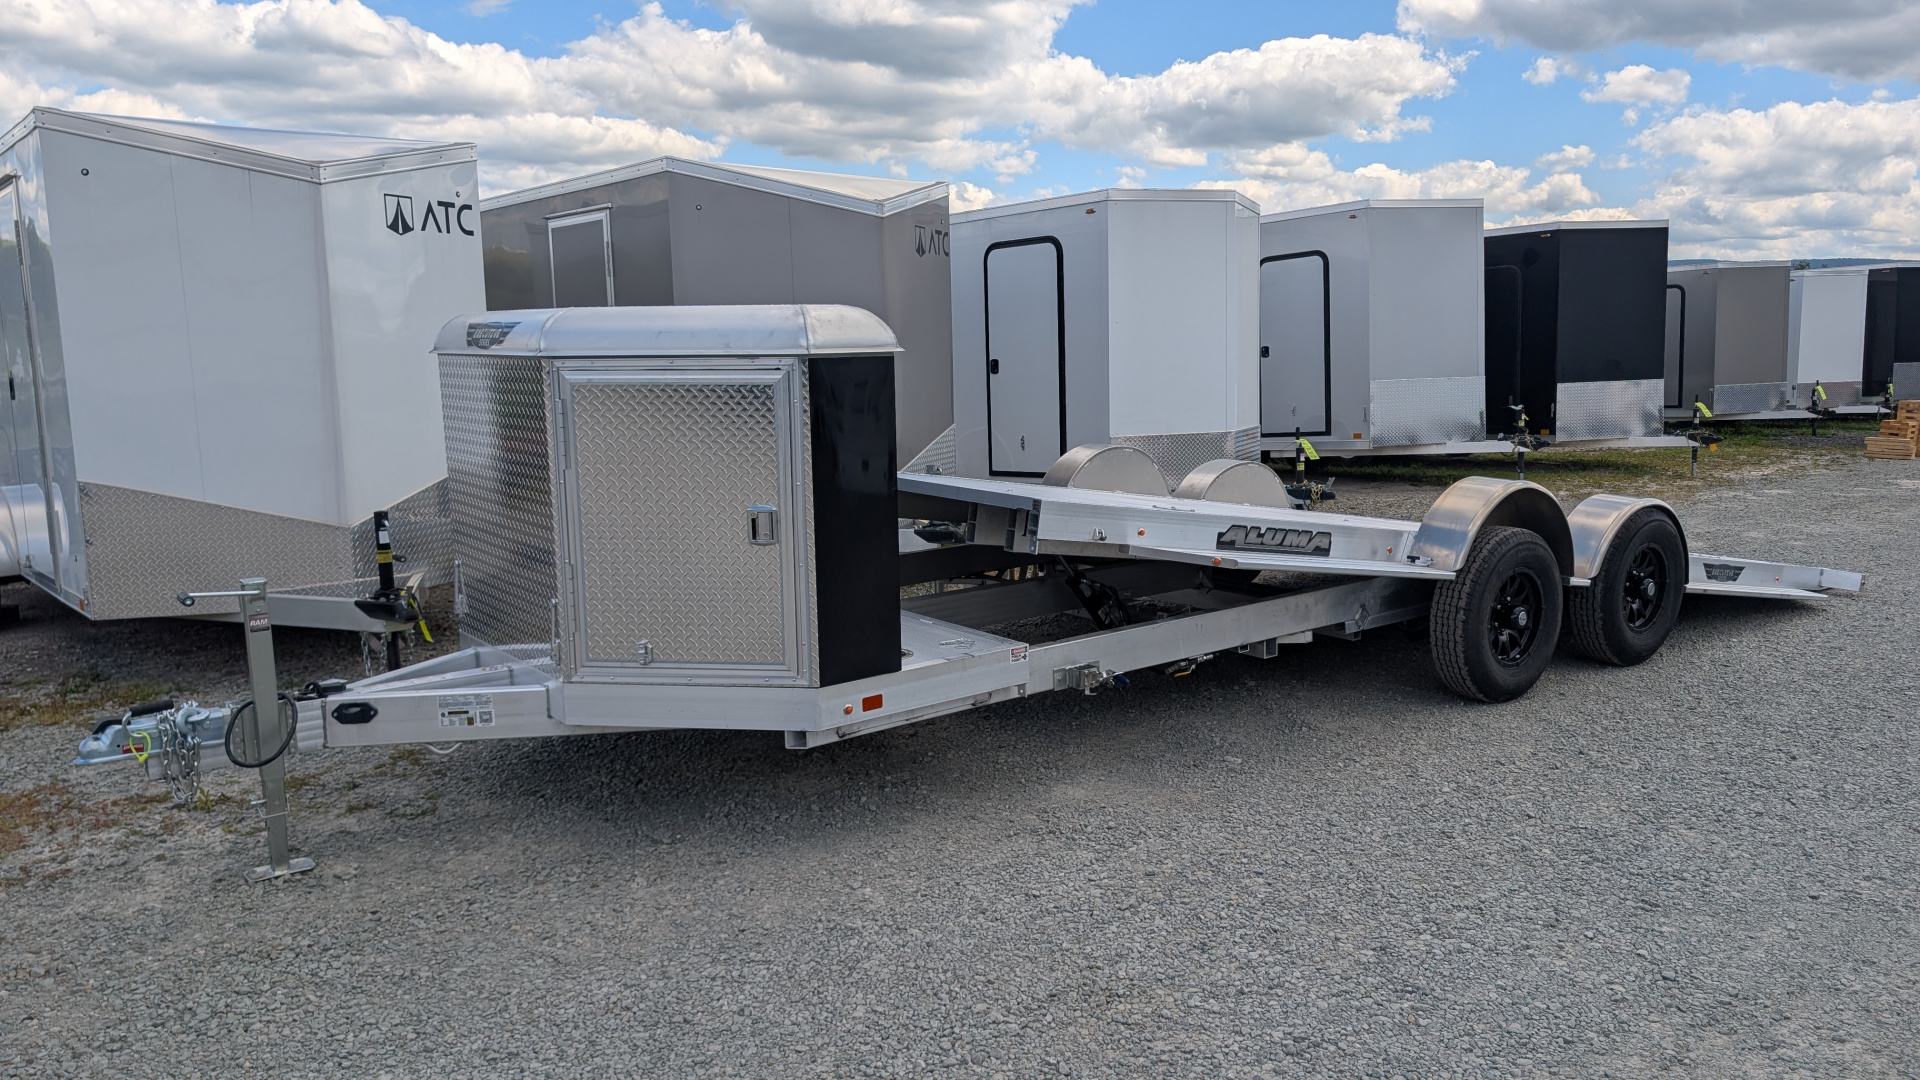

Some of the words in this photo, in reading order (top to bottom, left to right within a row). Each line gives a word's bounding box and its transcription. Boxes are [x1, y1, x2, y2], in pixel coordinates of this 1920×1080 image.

[421, 200, 474, 236] ATC
[928, 229, 949, 257] ATC
[1219, 525, 1331, 551] ALUMA
[250, 618, 268, 627] RAM
